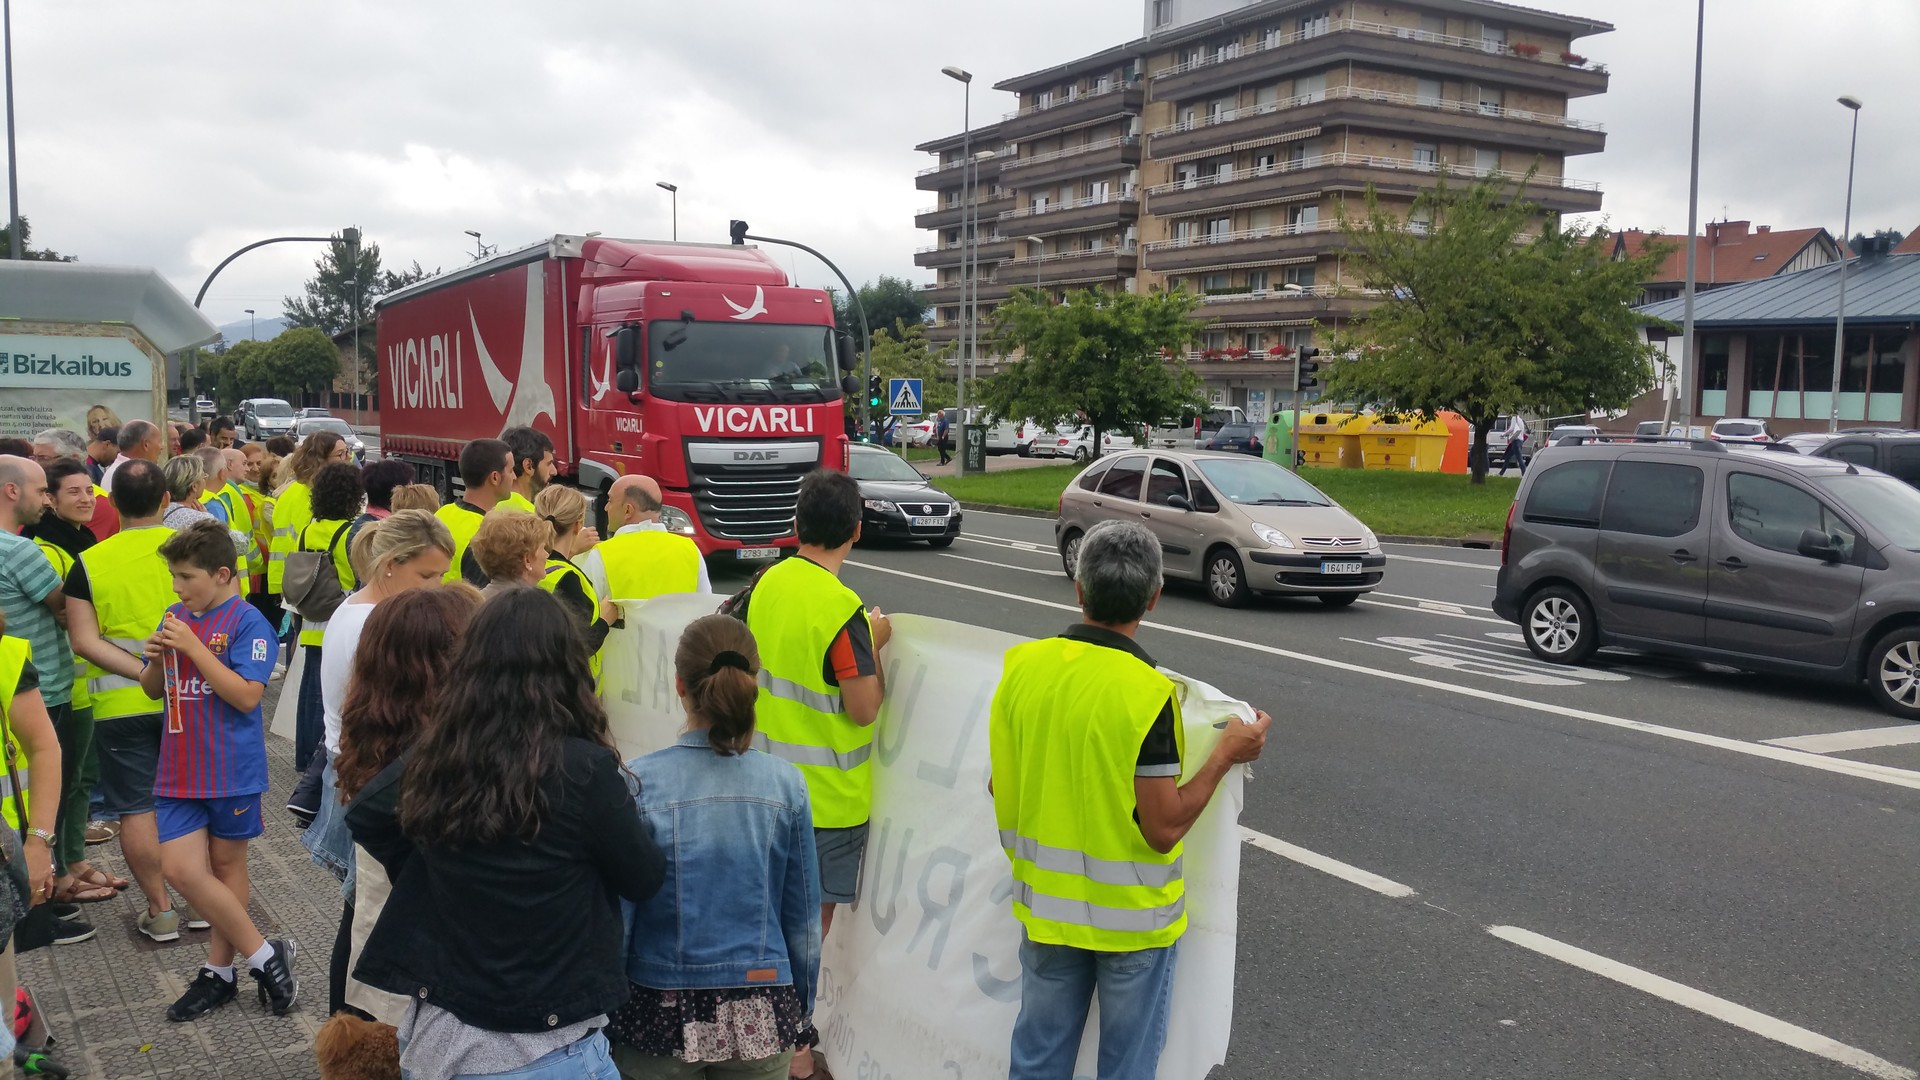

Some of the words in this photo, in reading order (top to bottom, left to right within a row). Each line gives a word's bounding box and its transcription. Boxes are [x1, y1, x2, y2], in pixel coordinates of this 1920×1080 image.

[13, 353, 132, 378] Bizkaibus
[389, 330, 463, 410] VICARLI
[615, 416, 643, 433] VICARLI
[694, 406, 814, 433] VICARLI
[733, 451, 779, 461] DAF
[742, 549, 761, 558] 2783
[1326, 563, 1344, 573] 1641
[1346, 563, 1361, 573] FLP
